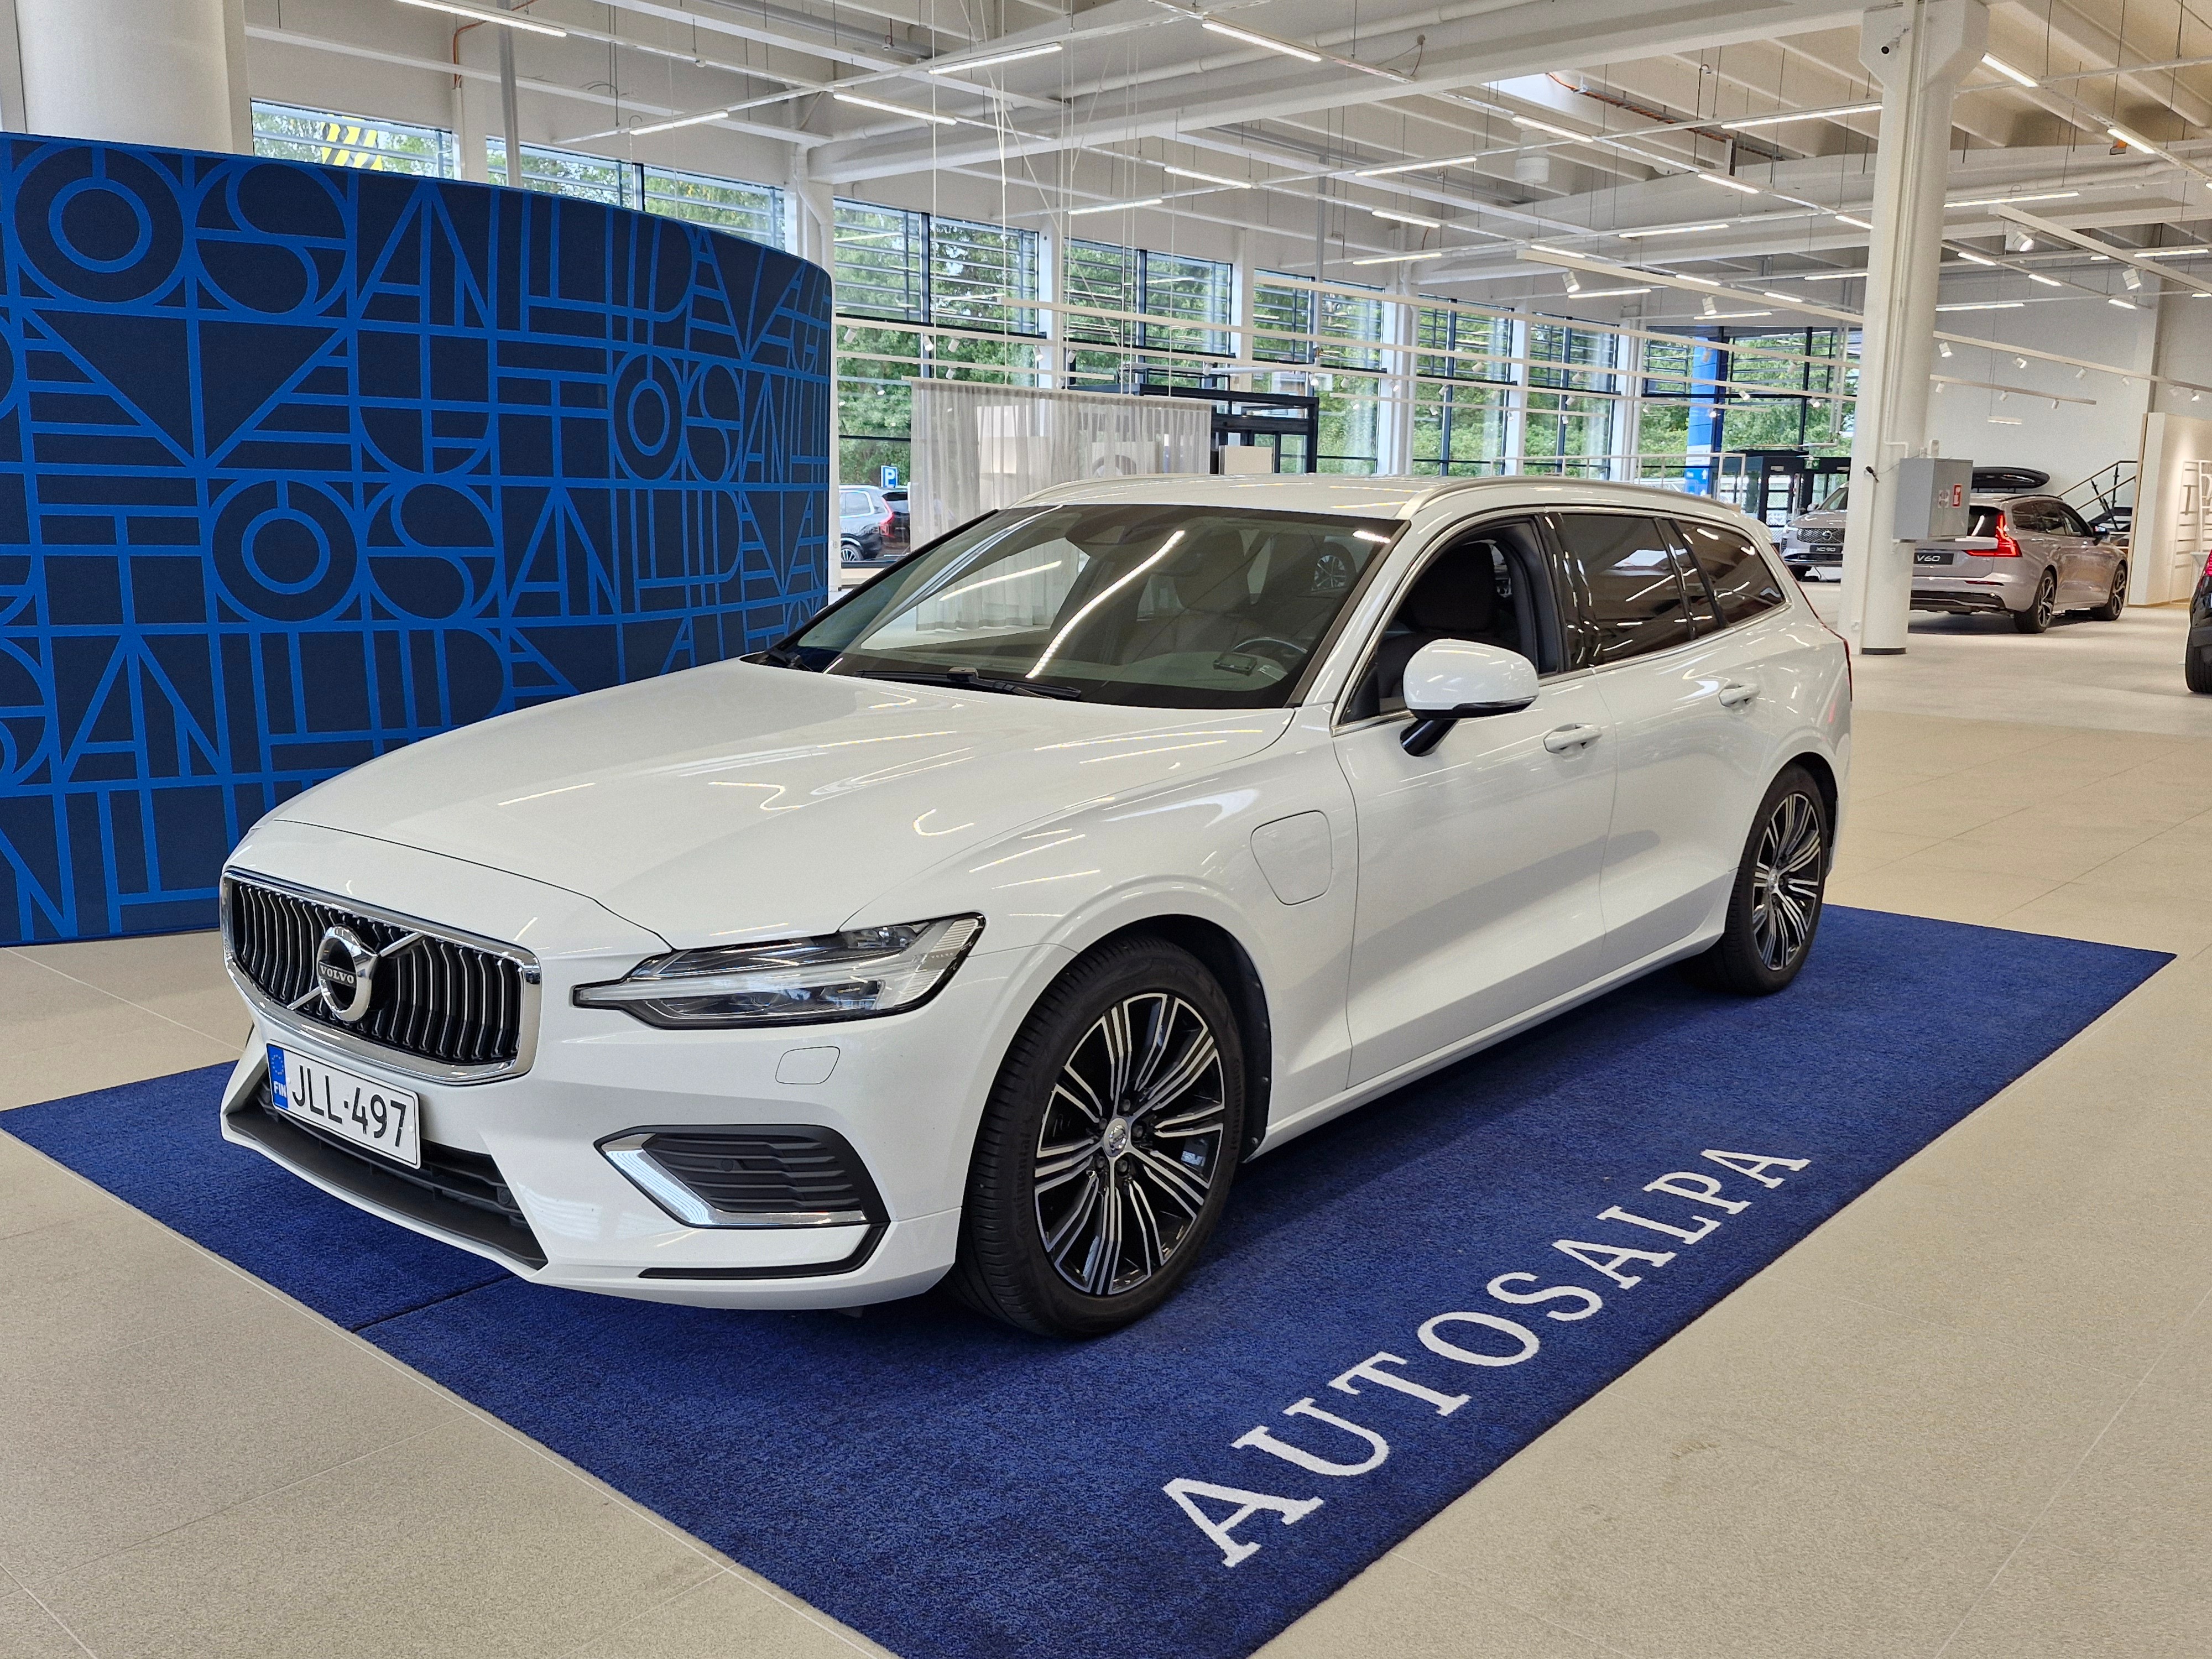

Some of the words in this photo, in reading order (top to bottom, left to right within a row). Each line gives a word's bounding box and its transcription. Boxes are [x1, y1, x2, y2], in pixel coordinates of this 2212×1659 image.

[885, 468, 895, 487] P
[320, 965, 354, 984] VOLVO
[274, 1081, 287, 1097] FIN
[292, 1065, 406, 1147] JLL-497
[1162, 1149, 1812, 1568] AUTOSALPA
